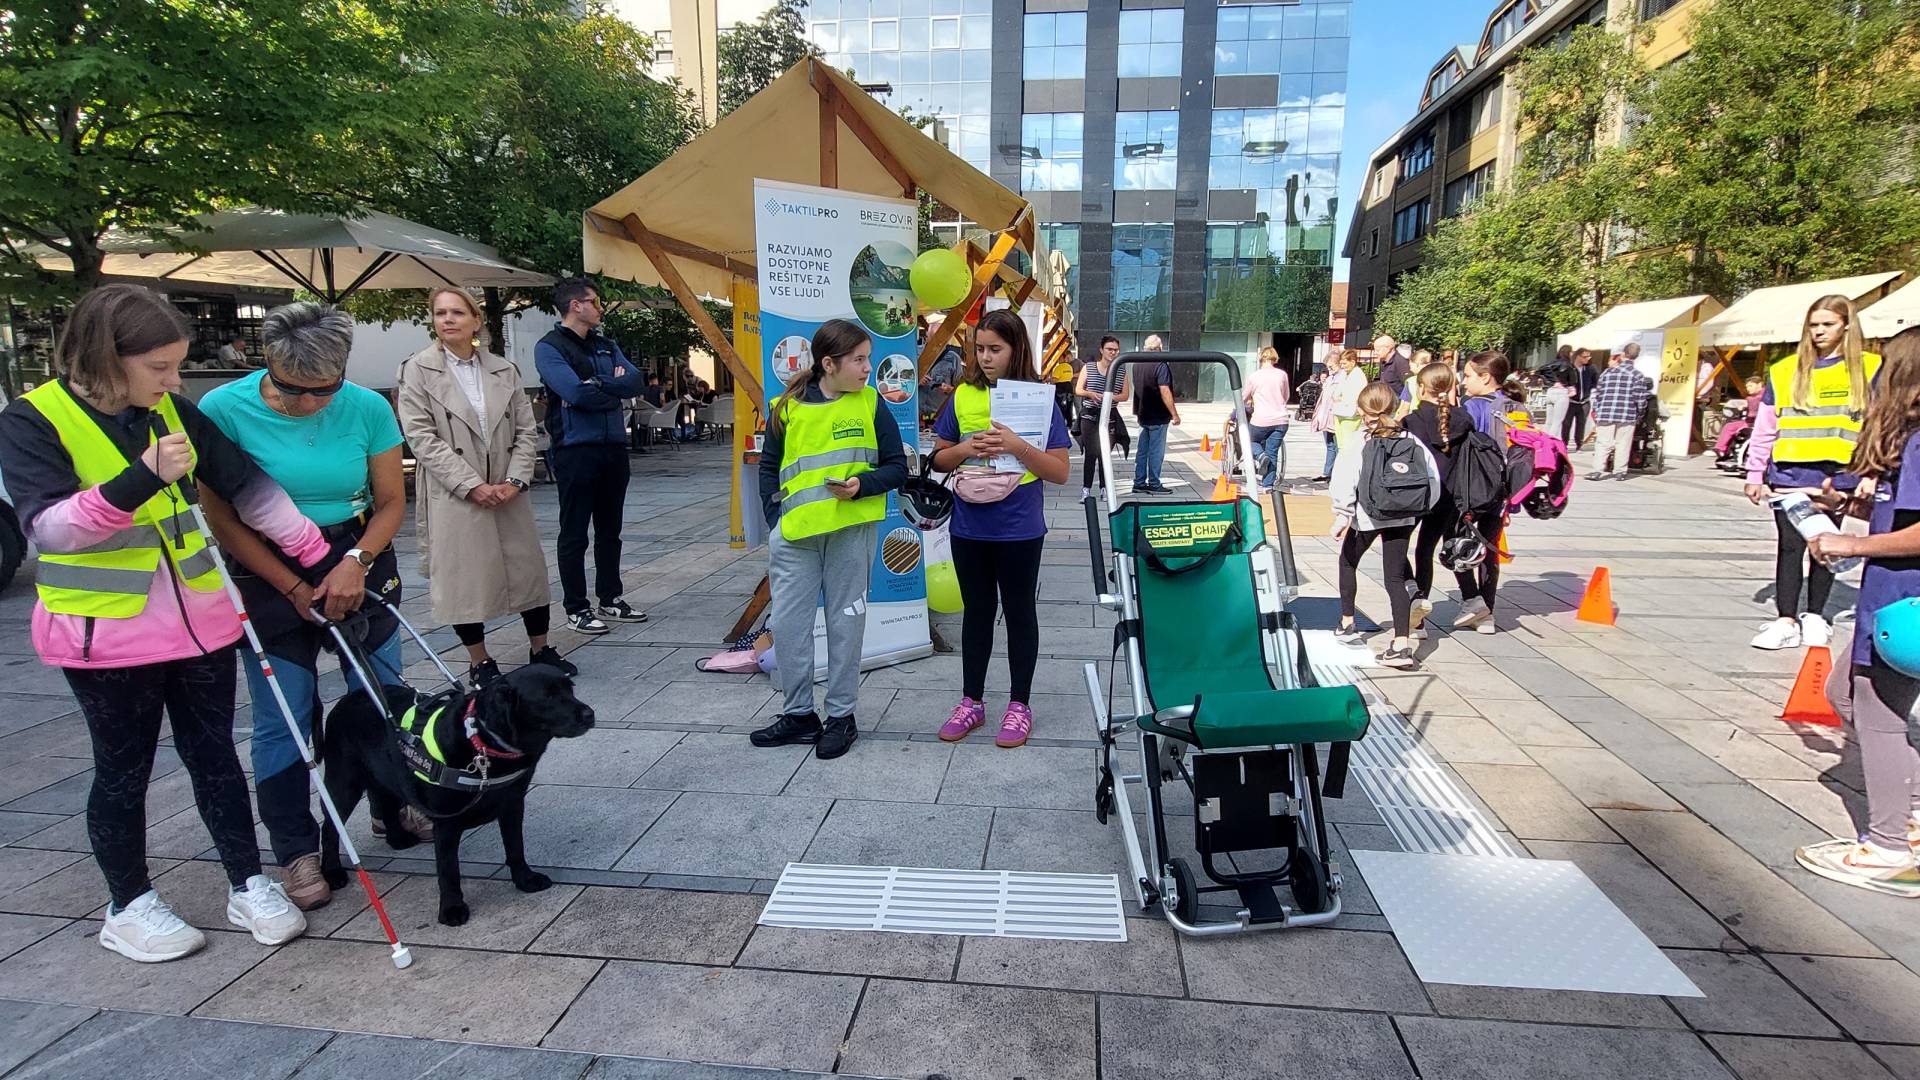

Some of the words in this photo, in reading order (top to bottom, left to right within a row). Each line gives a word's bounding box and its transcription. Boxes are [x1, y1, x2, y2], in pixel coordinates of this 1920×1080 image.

[781, 203, 839, 219] TAKTILPRO
[860, 209, 887, 223] BREZ
[767, 243, 833, 258] RAZVIJAMO
[768, 257, 830, 272] DOSTOPNE
[769, 270, 814, 285] REŠITVE
[816, 274, 831, 286] ZA
[769, 285, 791, 297] VSE
[794, 287, 824, 299] LJUDI
[1145, 526, 1191, 539] ESCAPE
[1194, 524, 1227, 535] CHAIR
